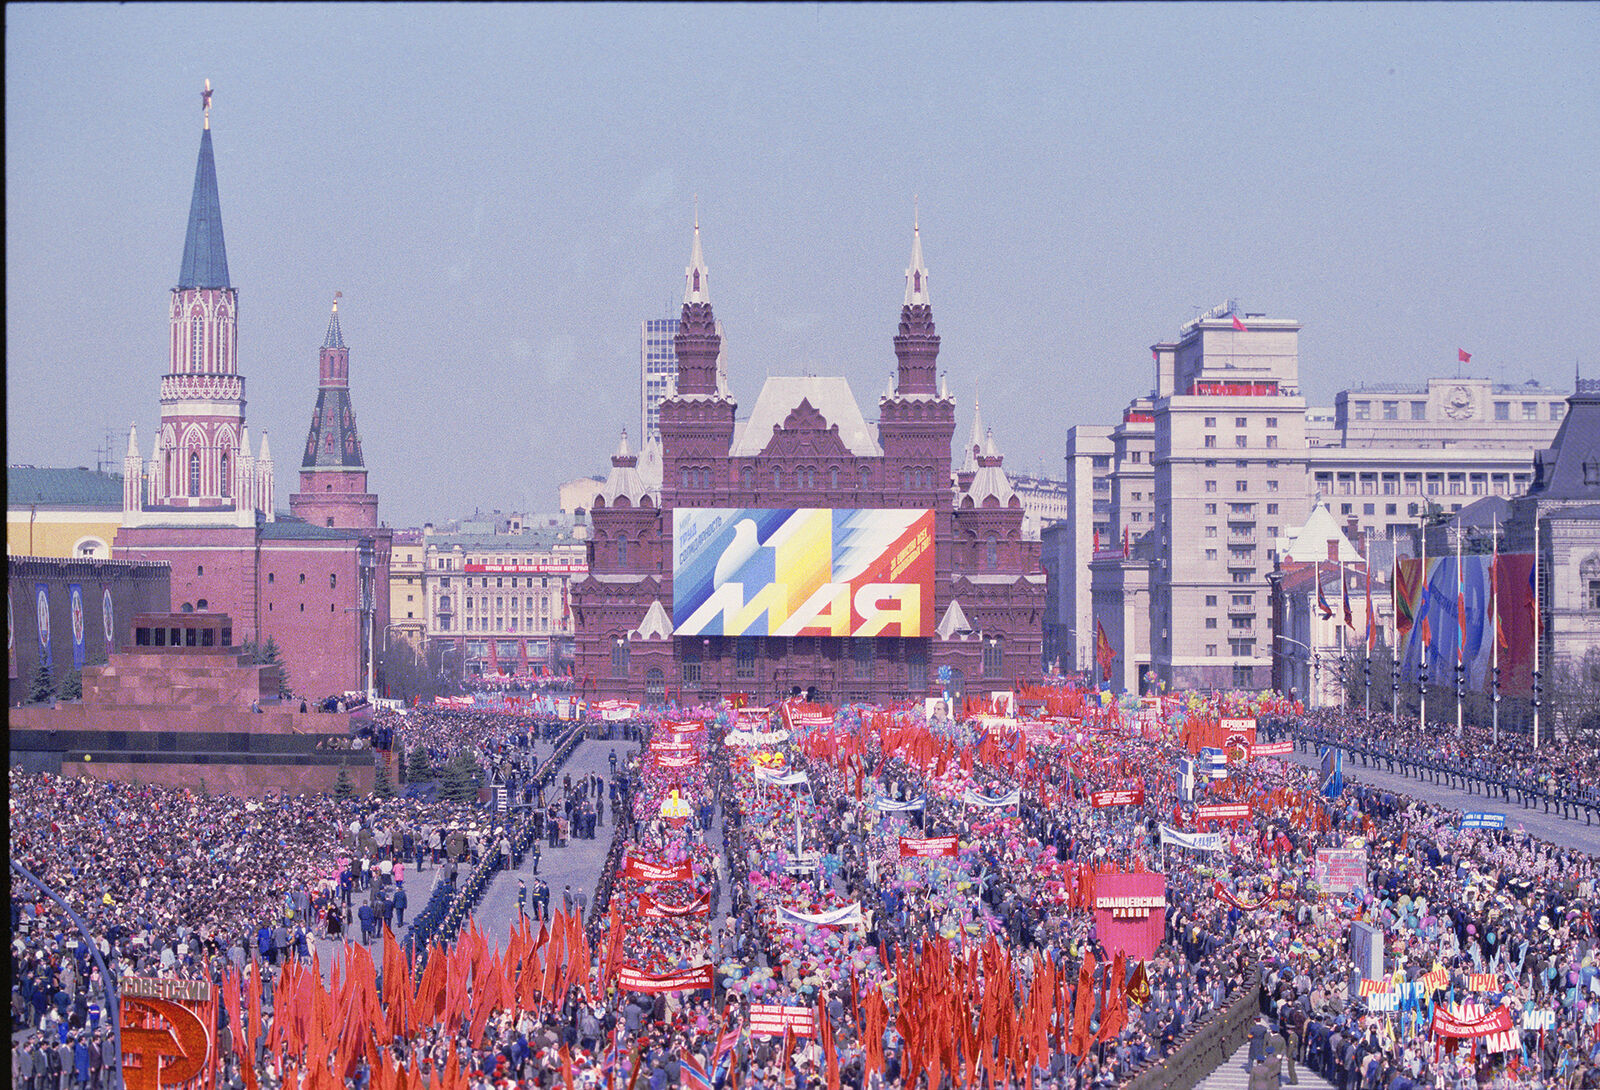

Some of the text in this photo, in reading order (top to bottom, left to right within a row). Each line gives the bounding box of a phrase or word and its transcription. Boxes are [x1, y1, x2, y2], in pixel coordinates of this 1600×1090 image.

[760, 508, 832, 612] 1
[672, 583, 920, 636] МАЯ
[669, 790, 679, 807] 1
[663, 808, 688, 816] МАЯ
[1097, 896, 1166, 908] СОЛНЦЕВСКИЙ
[1113, 908, 1149, 918] РАЙОН
[1424, 968, 1450, 995] ТРУД
[1470, 974, 1497, 991] ТРУД
[1368, 993, 1399, 1011] МИР
[1523, 1010, 1556, 1029] МИР
